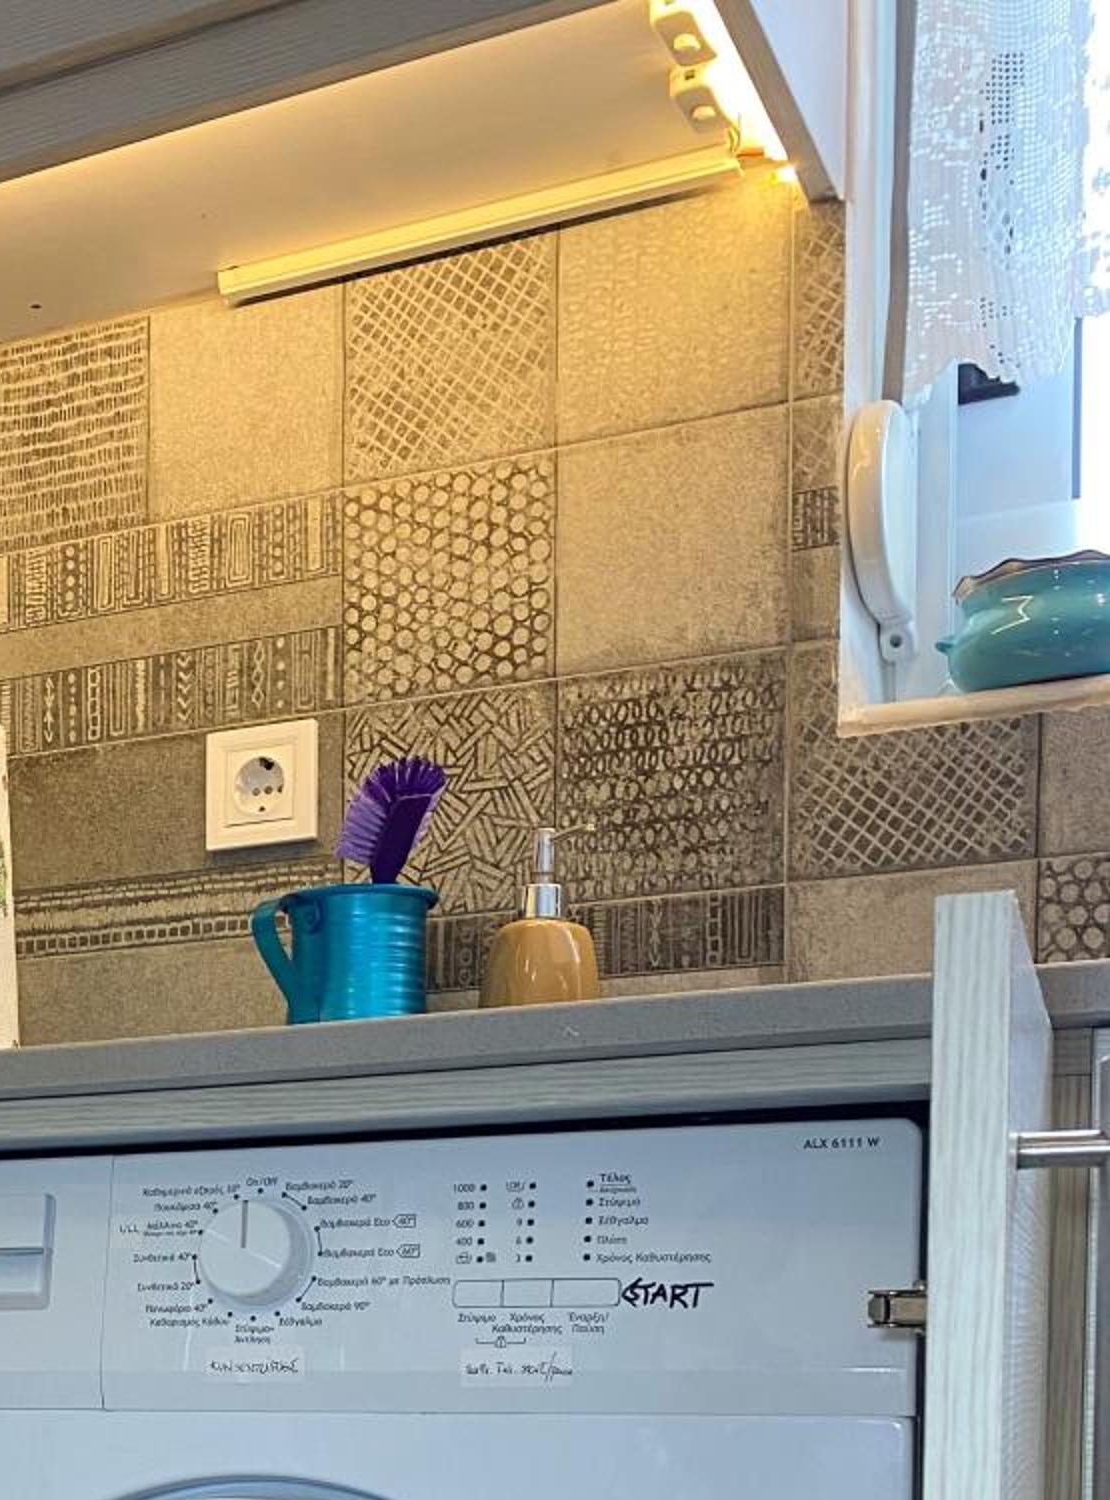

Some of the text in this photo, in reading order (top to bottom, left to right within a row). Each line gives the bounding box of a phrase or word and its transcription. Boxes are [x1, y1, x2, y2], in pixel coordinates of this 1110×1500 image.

[803, 1137, 878, 1149] ALX 6111 W
[453, 1183, 476, 1193] 1000
[626, 1281, 715, 1309] START
